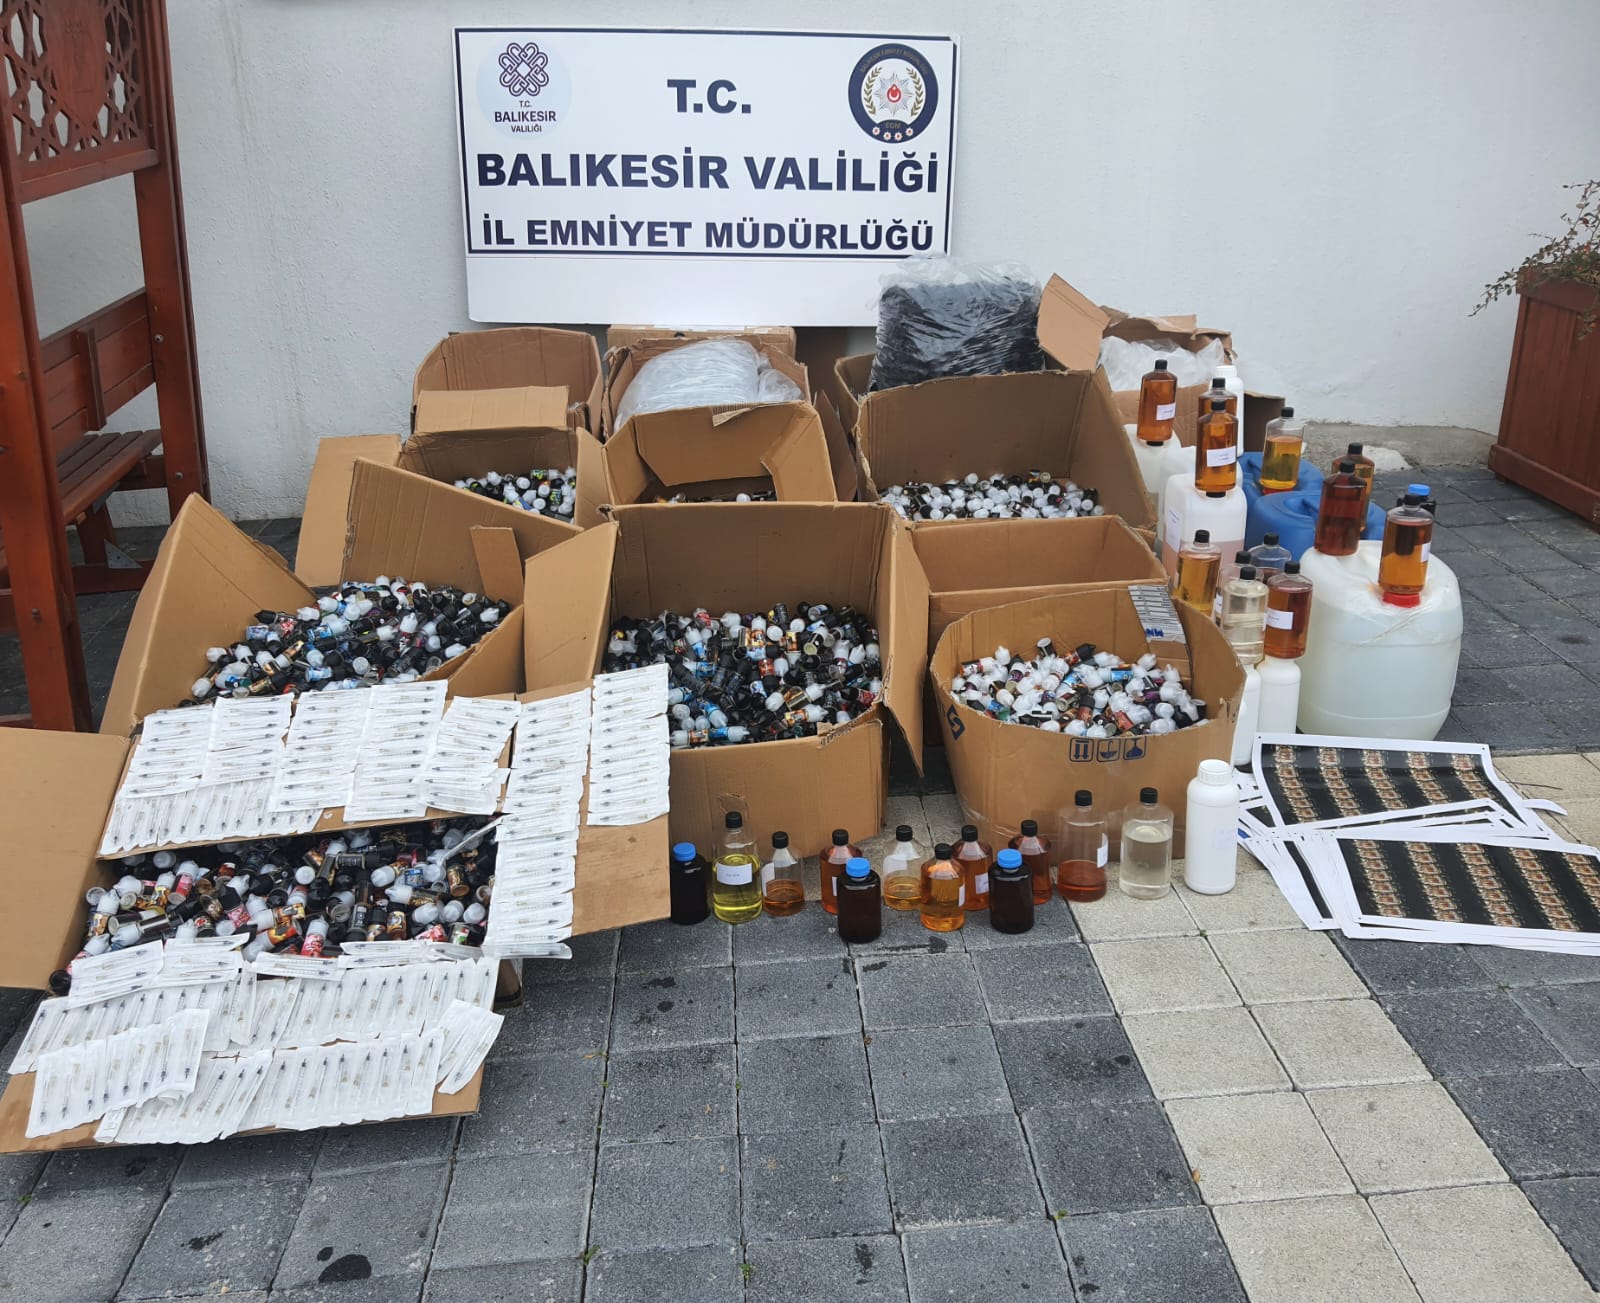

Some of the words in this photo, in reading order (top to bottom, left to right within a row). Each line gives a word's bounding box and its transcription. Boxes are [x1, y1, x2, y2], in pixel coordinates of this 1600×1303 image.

[519, 100, 532, 108] T.C.
[667, 79, 752, 114] T.C.
[477, 147, 729, 190] BALIKESİR
[744, 150, 939, 193] VALİLİĞİ
[483, 213, 515, 246] İL
[527, 214, 692, 249] EMNİYET
[705, 217, 934, 252] MÜDÜRLÜĞÜ
